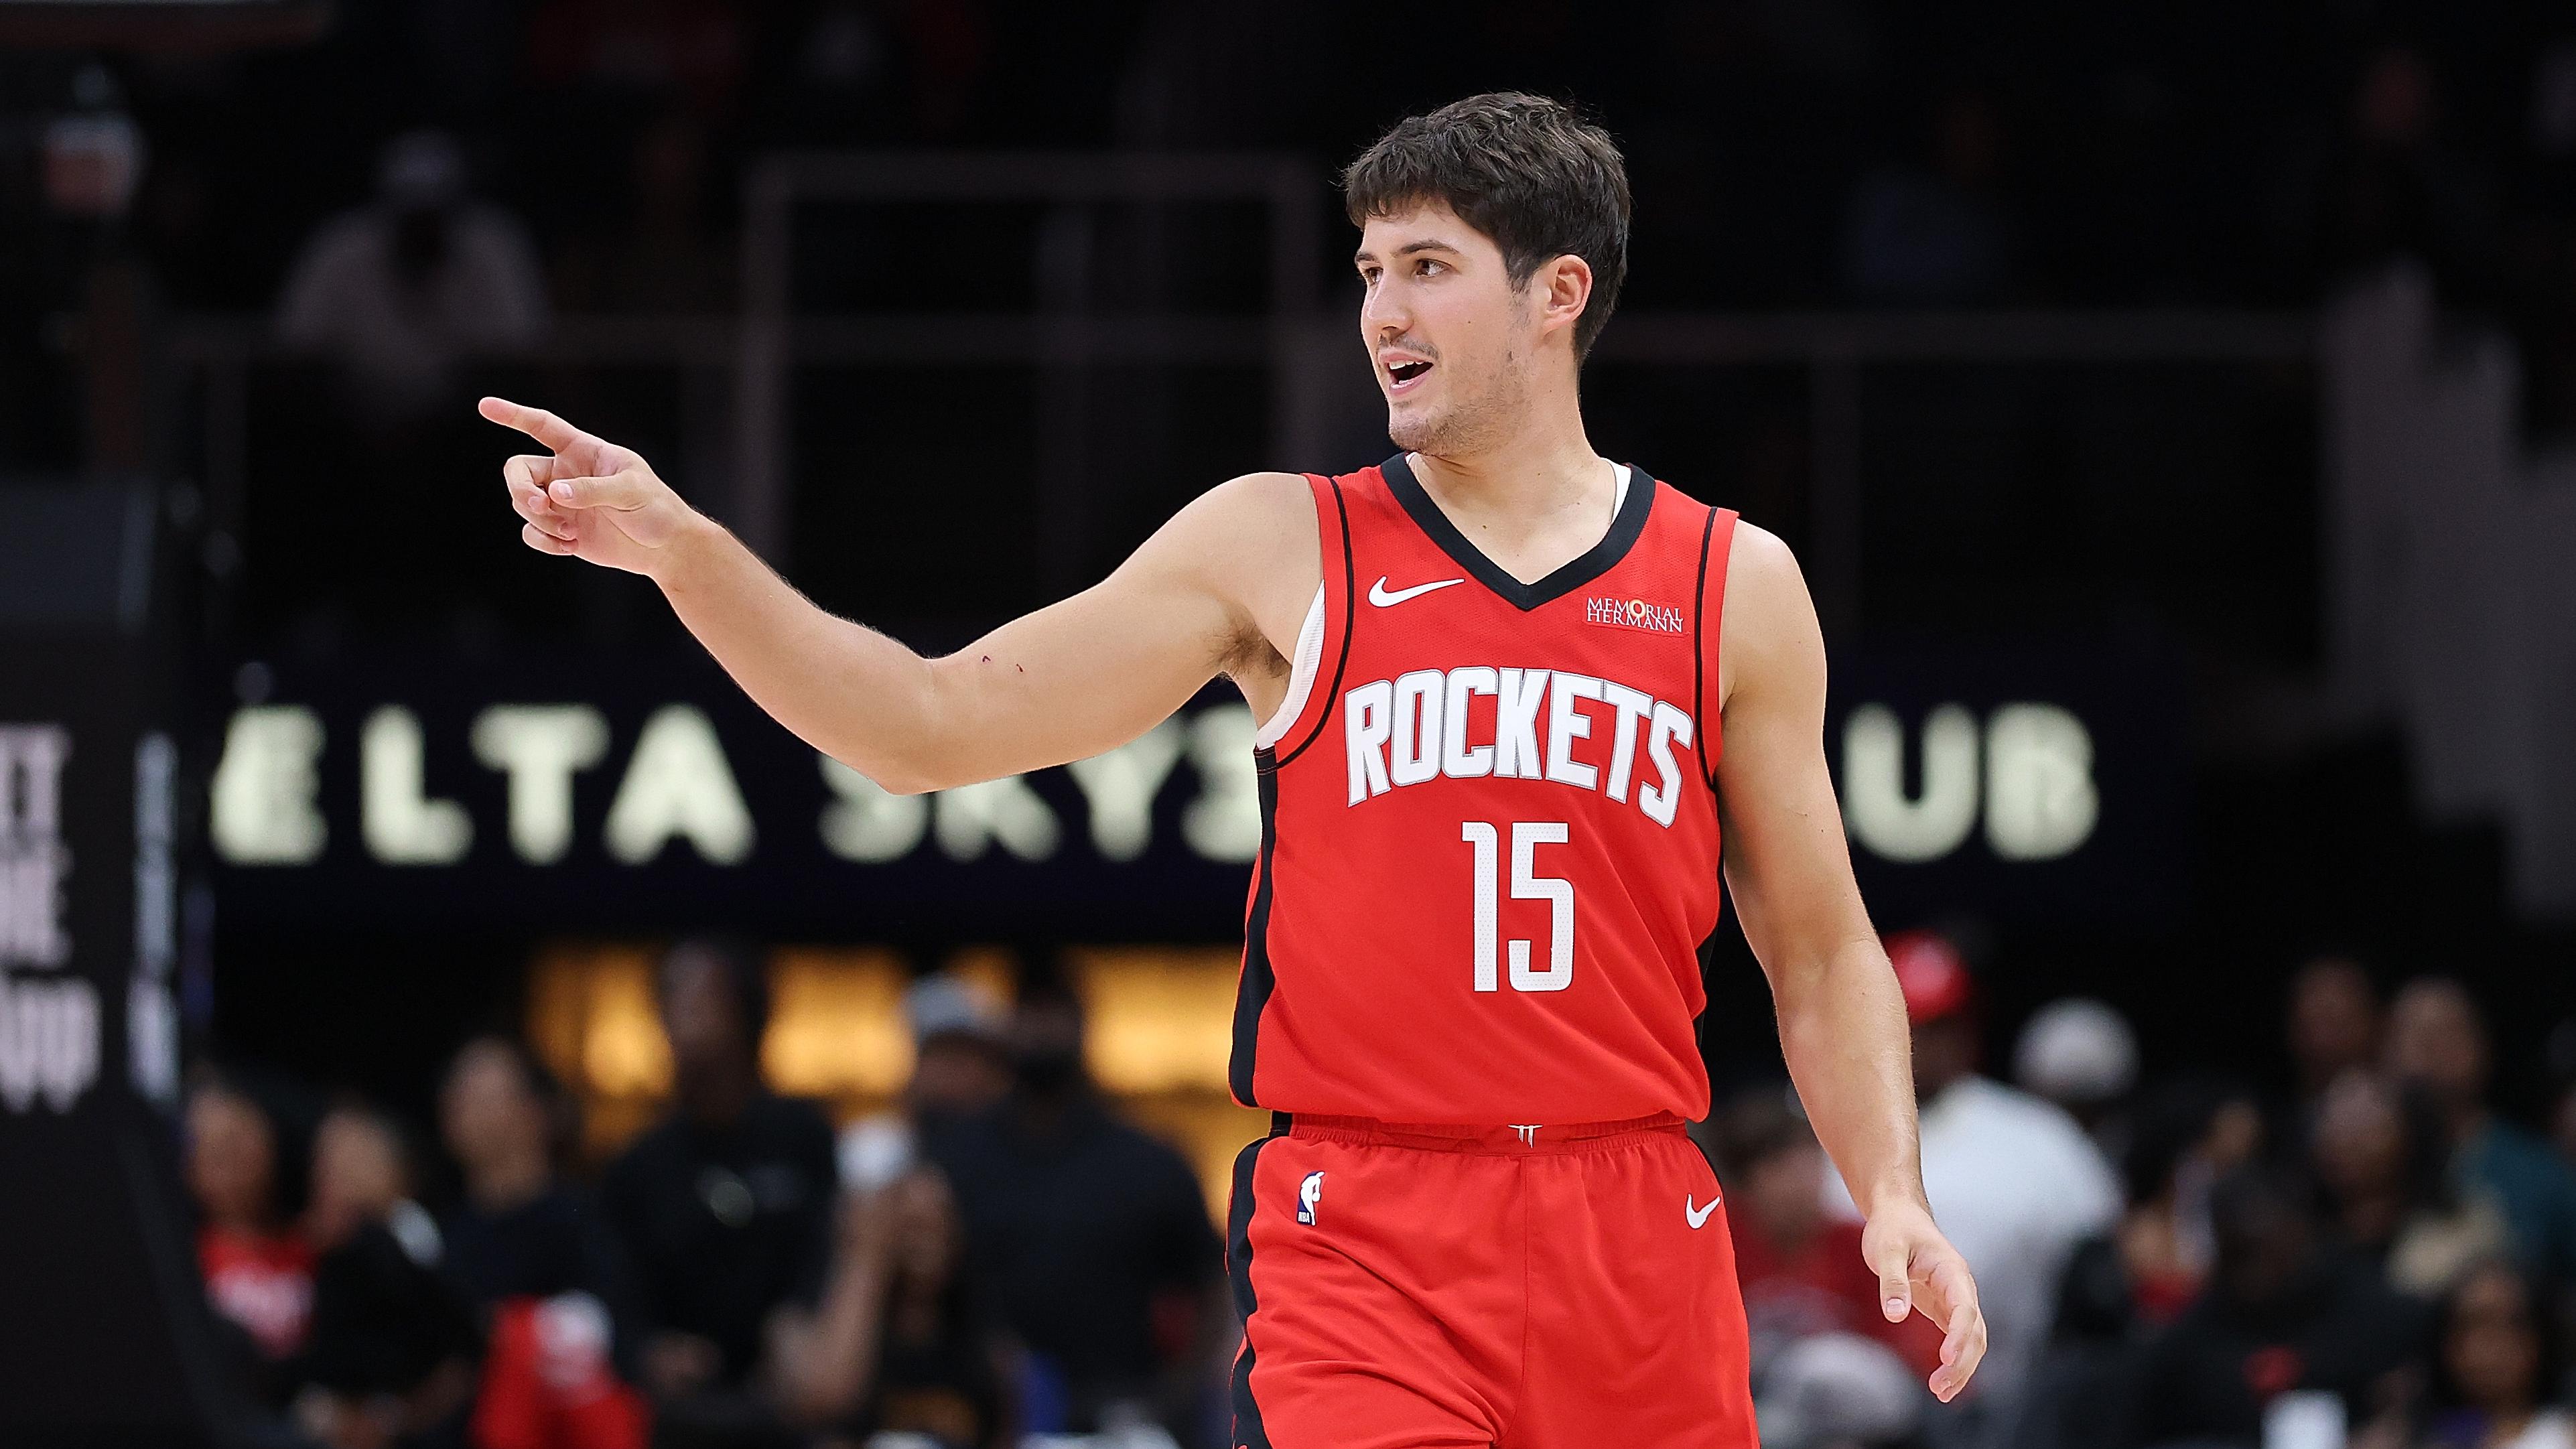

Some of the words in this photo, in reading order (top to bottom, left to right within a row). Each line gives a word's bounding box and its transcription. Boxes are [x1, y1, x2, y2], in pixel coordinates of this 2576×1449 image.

[1586, 608, 1683, 632] HERMANN
[1587, 598, 1684, 622] MEMORIAL
[1345, 666, 1694, 828] ROCKETS
[1461, 821, 1574, 991] 15
[1298, 1211, 1310, 1223] NBA
